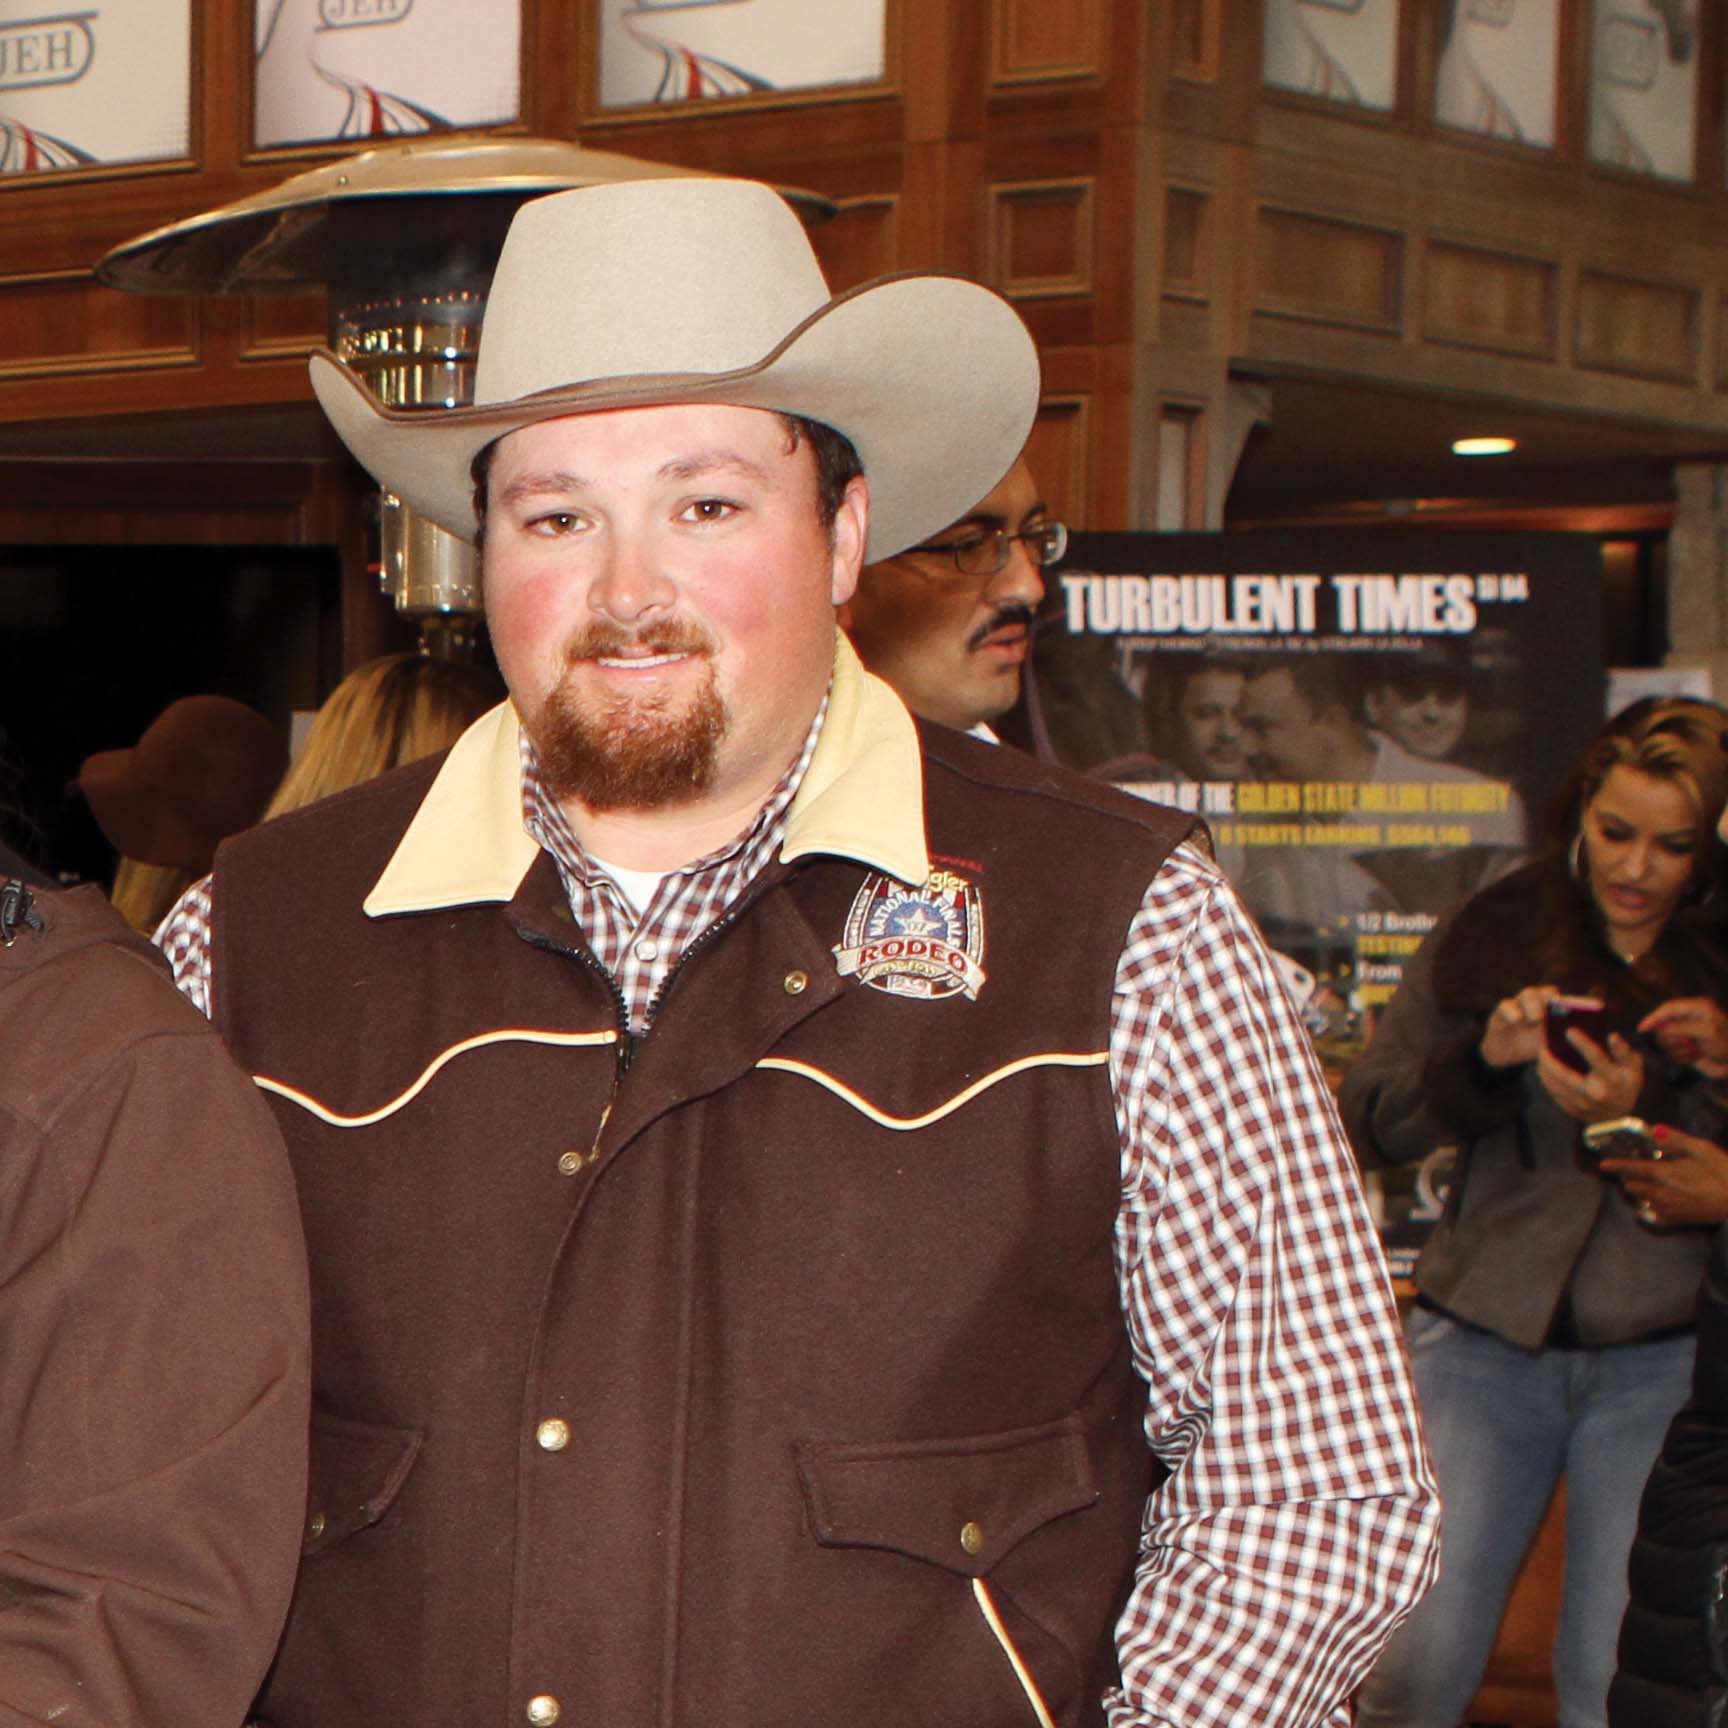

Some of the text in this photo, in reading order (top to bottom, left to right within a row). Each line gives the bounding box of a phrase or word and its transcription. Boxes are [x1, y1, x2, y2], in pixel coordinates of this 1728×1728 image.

[1060, 573, 1321, 634] TURBULENT
[1332, 573, 1477, 634] TIMES
[1203, 782, 1233, 813] THE
[870, 887, 932, 936] NATIONAL
[859, 940, 968, 973] RODEO
